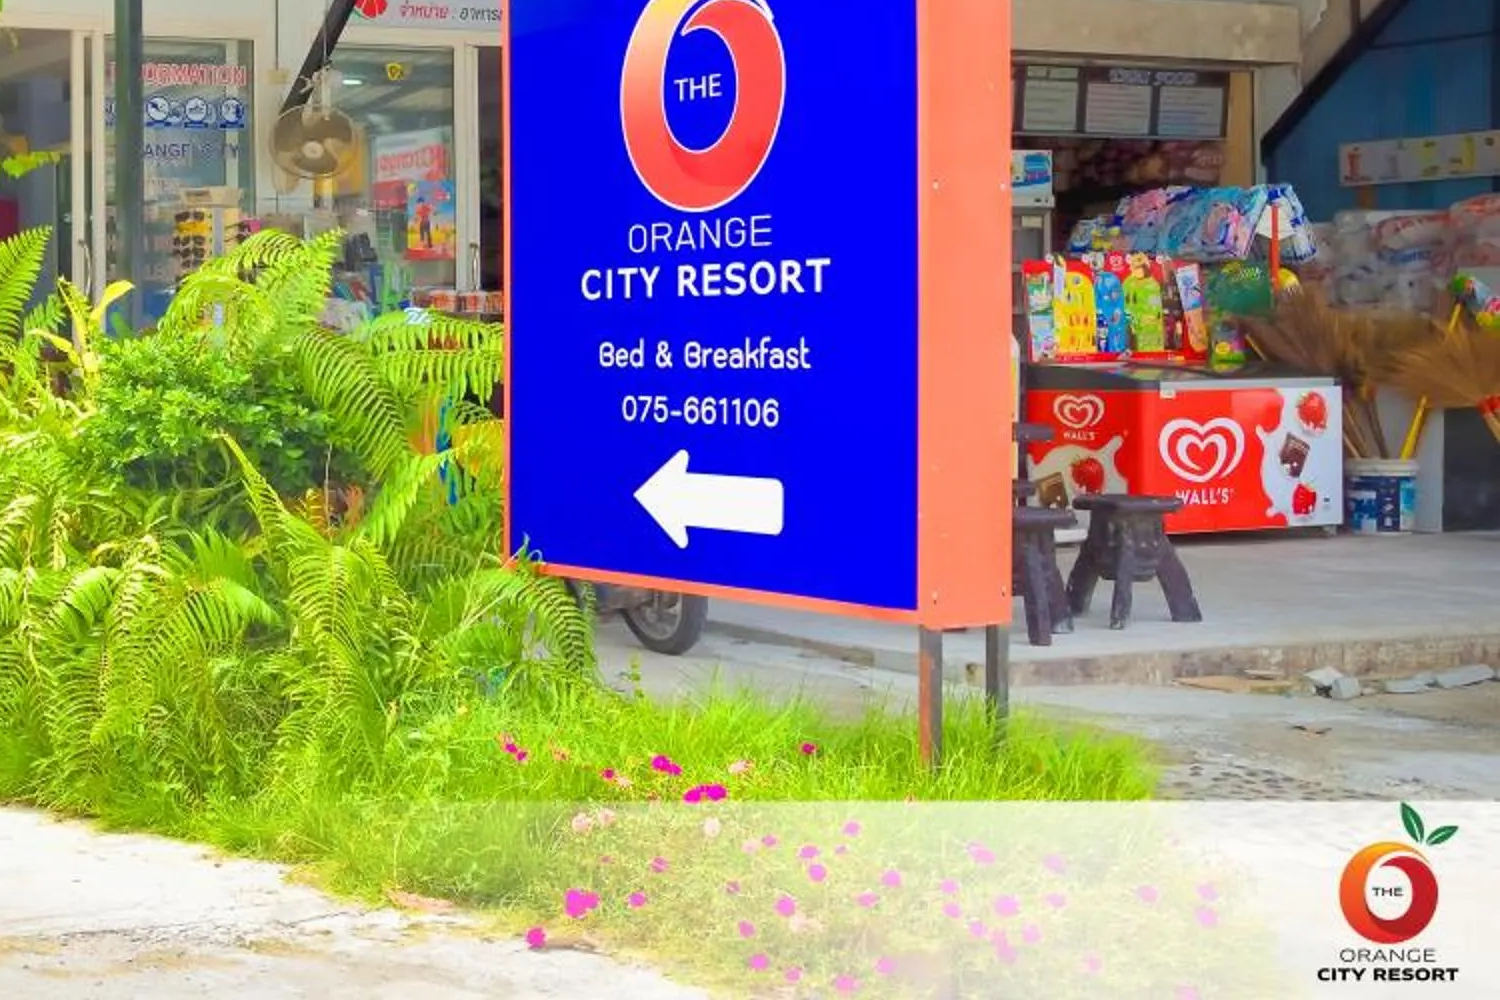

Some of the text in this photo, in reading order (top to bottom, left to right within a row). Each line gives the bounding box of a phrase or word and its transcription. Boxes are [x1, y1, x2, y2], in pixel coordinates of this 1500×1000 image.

[459, 6, 502, 22] อาหาร
[674, 73, 722, 102] THE
[628, 214, 772, 253] ORANGE
[581, 257, 831, 301] CITY RESORT
[599, 335, 812, 370] Bed & Breakfast
[621, 395, 779, 428] 075-661106
[1174, 487, 1230, 505] WALL'S
